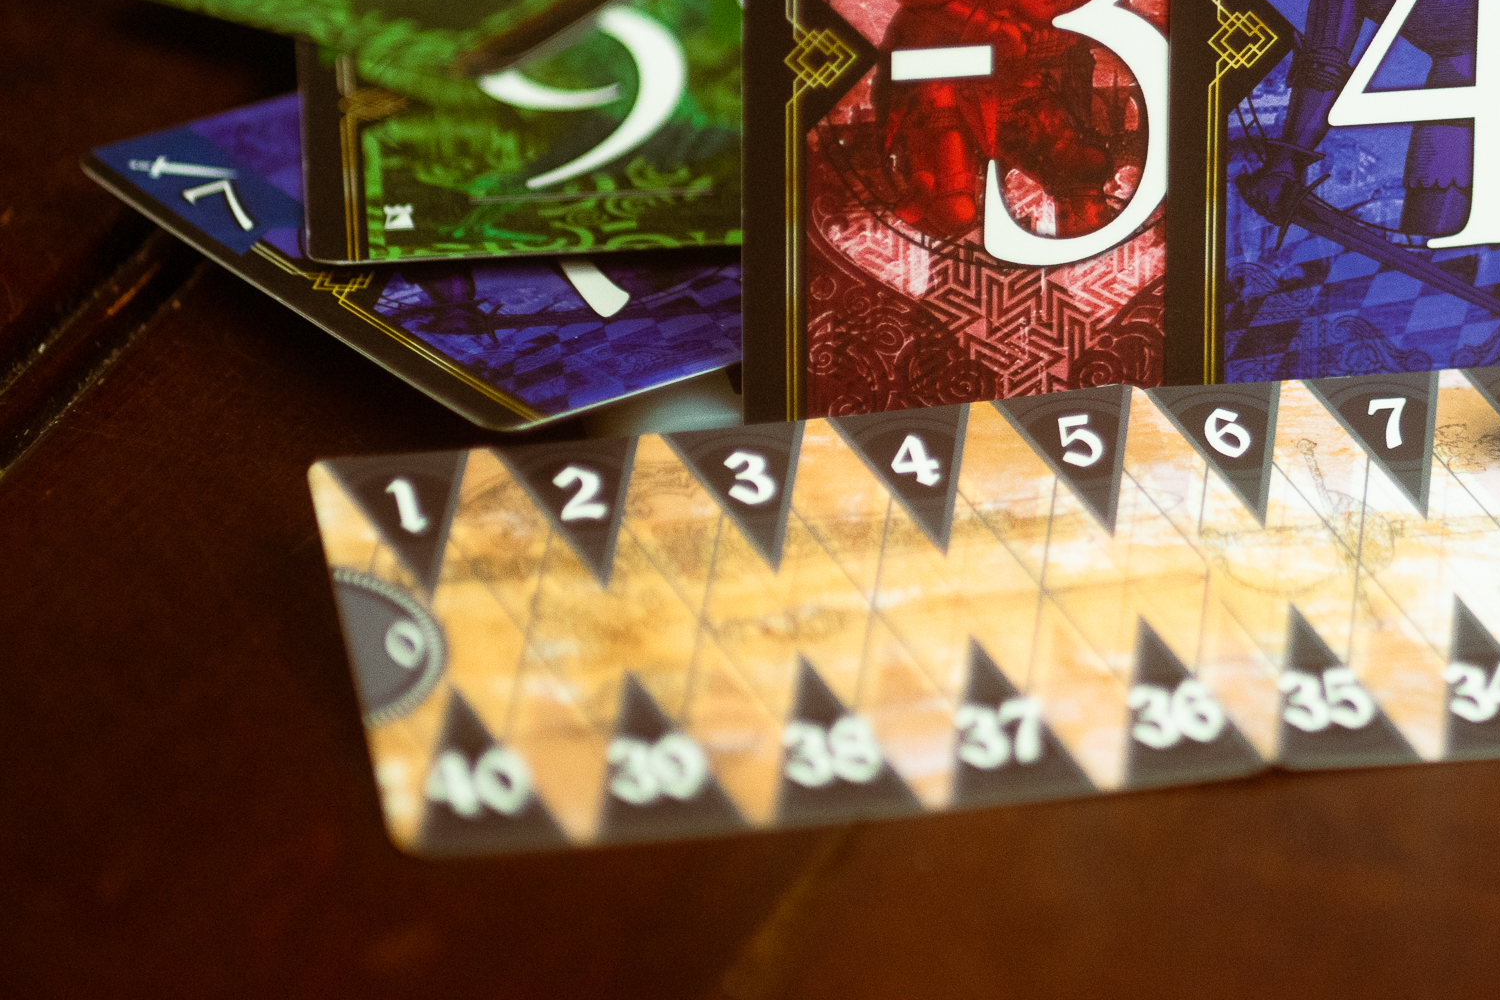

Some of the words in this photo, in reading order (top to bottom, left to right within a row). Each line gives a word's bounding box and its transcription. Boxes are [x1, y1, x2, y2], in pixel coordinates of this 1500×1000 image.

[183, 178, 253, 231] 7
[1056, 412, 1105, 469] 5
[1203, 407, 1253, 459] 6
[1367, 397, 1408, 450] 7
[722, 450, 777, 506] 3
[890, 433, 942, 488] 4
[385, 478, 429, 534] 1
[552, 465, 608, 522] 2
[385, 616, 424, 670] 0
[1129, 679, 1225, 749] 36
[1278, 667, 1377, 732] 35
[782, 713, 882, 788] 38
[955, 702, 1042, 769] 37
[425, 747, 530, 818] 40
